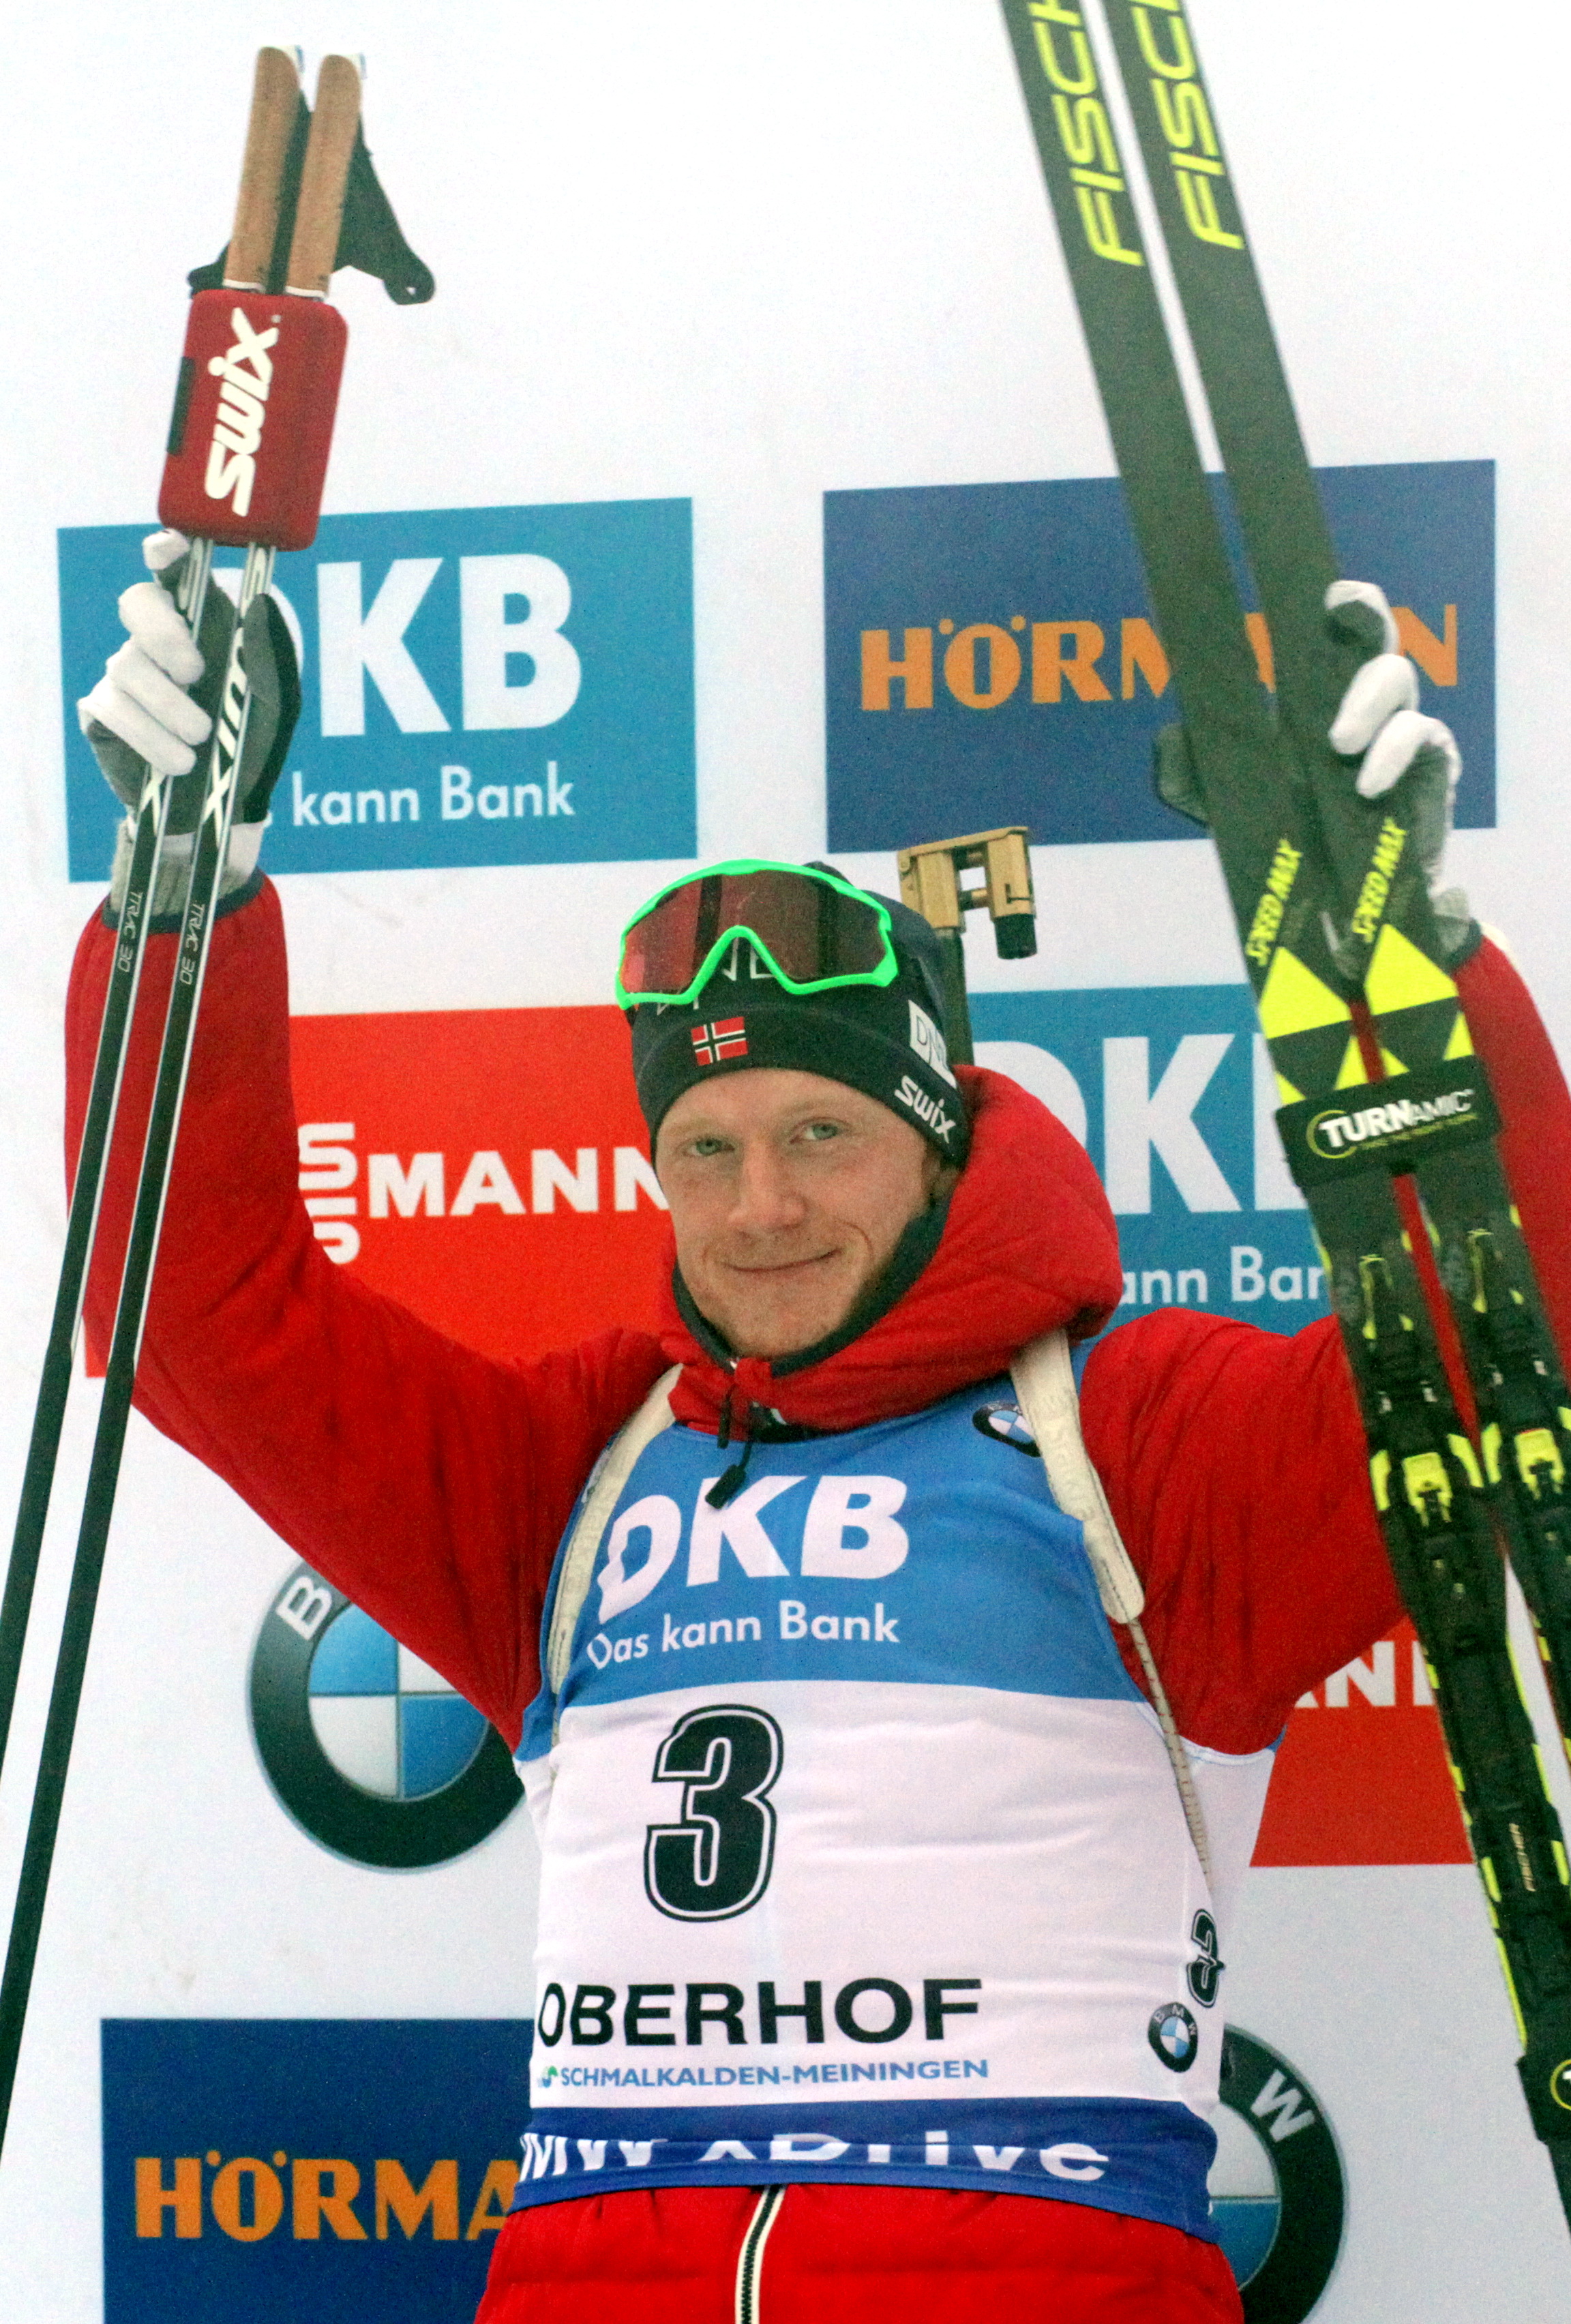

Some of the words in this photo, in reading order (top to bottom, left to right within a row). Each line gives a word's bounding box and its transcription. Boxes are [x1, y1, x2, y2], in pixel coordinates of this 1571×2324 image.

[1131, 0, 1245, 250] FISC
[211, 553, 582, 737] KB
[292, 771, 421, 826] kann
[440, 760, 575, 820] Bank
[1318, 1090, 1474, 1149] TURNAMIC
[596, 1475, 910, 1624] DKB
[586, 1632, 649, 1670] Das
[660, 1613, 762, 1652] kann
[779, 1600, 900, 1643] Bank
[644, 1703, 785, 1923] 3
[537, 1978, 983, 2048] OBERHOF
[561, 2059, 989, 2087] SCHMALKALDEN-MEININGEN
